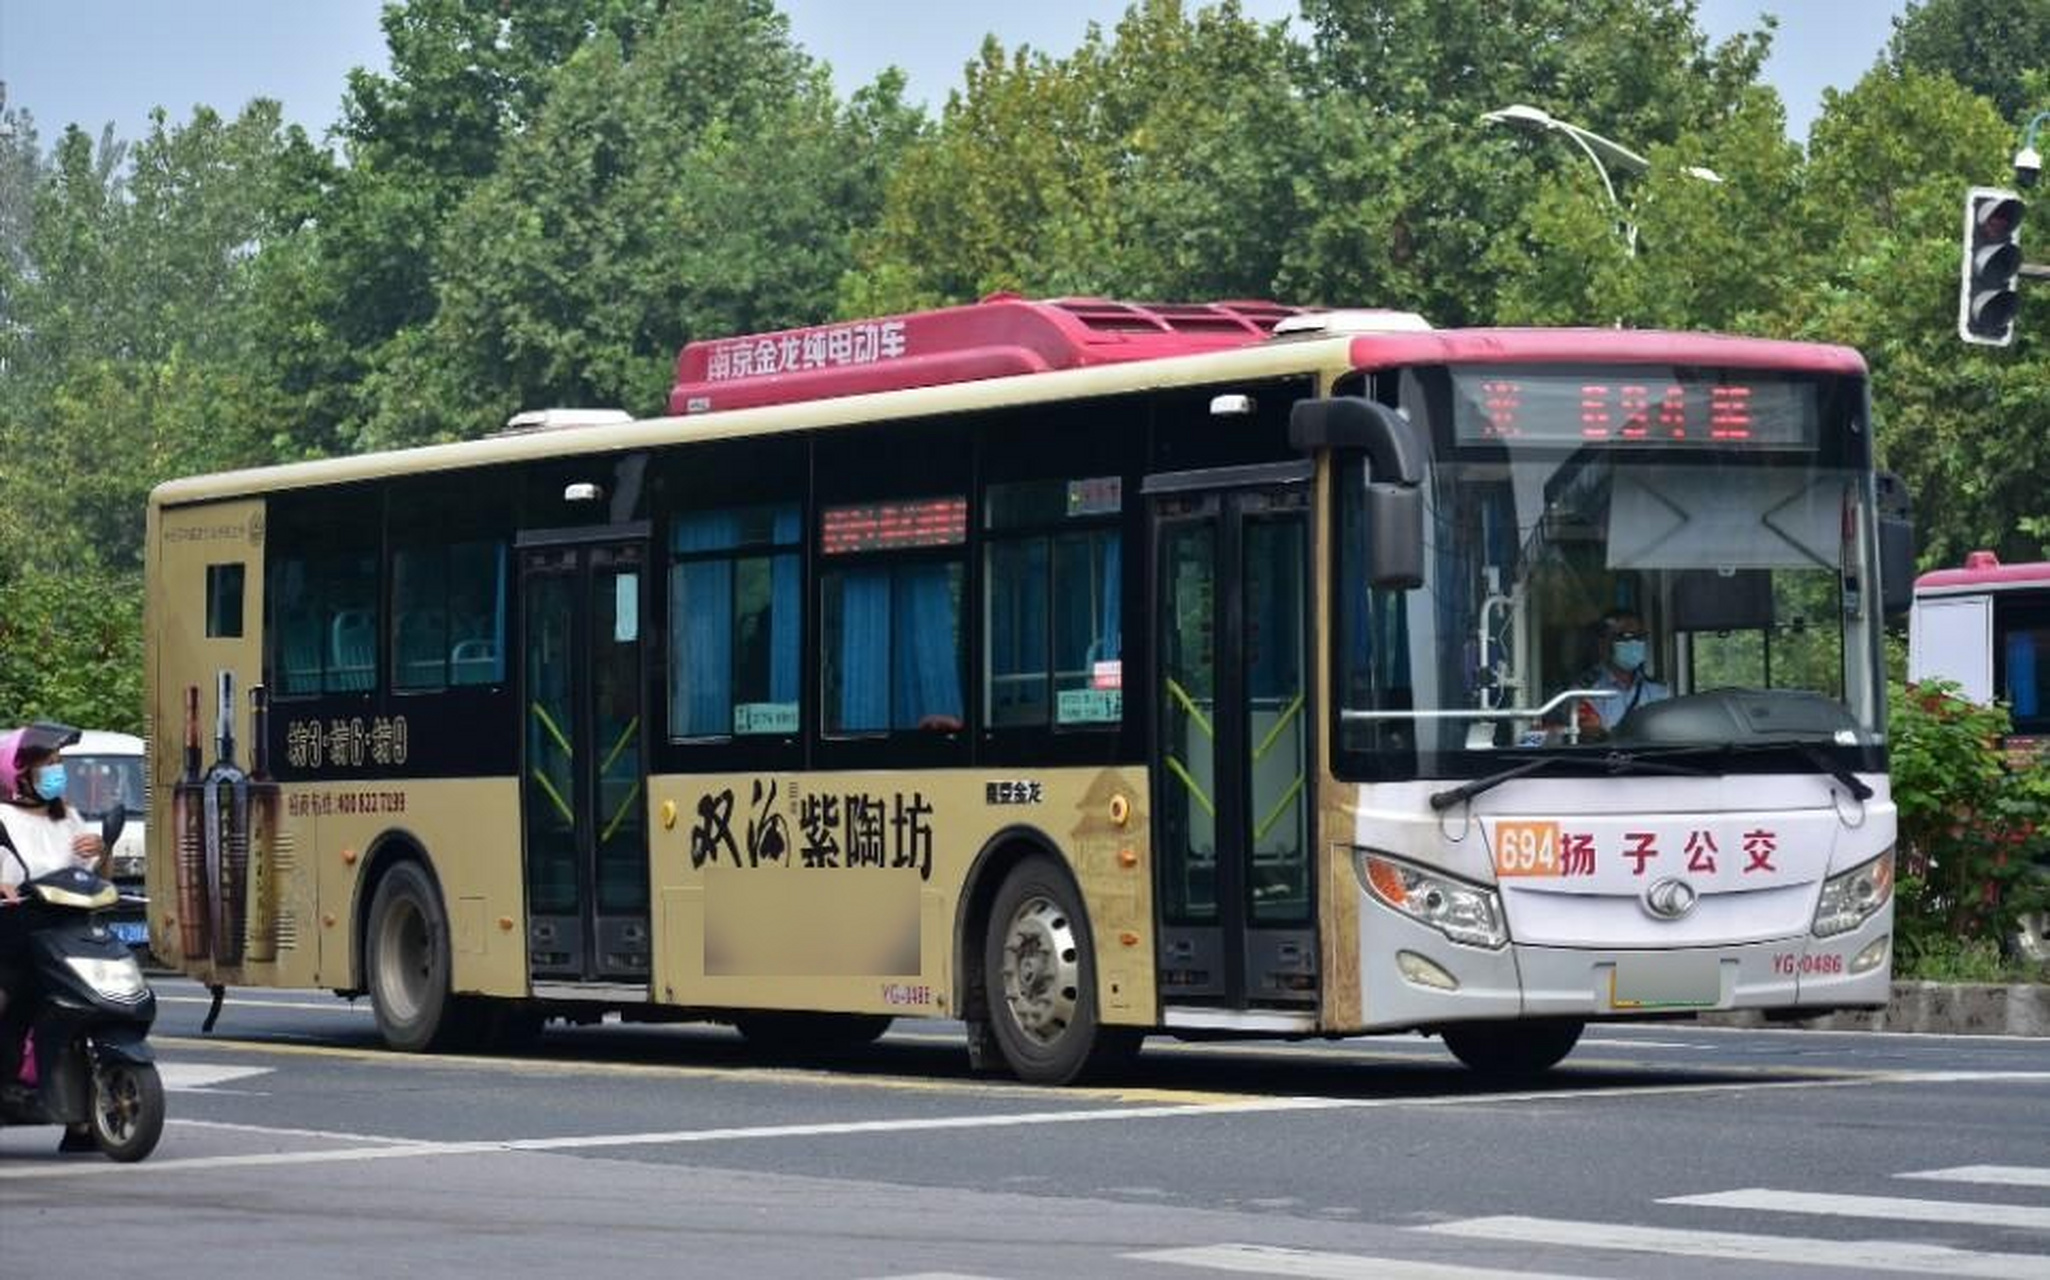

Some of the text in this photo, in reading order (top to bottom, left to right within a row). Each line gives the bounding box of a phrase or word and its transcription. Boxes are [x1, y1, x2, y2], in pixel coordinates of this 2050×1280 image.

[706, 322, 906, 382] 南京金龙纯电动车
[799, 791, 934, 881] 紫陶坊
[1502, 824, 1557, 869] 694
[1561, 830, 1777, 875] 扬子公交
